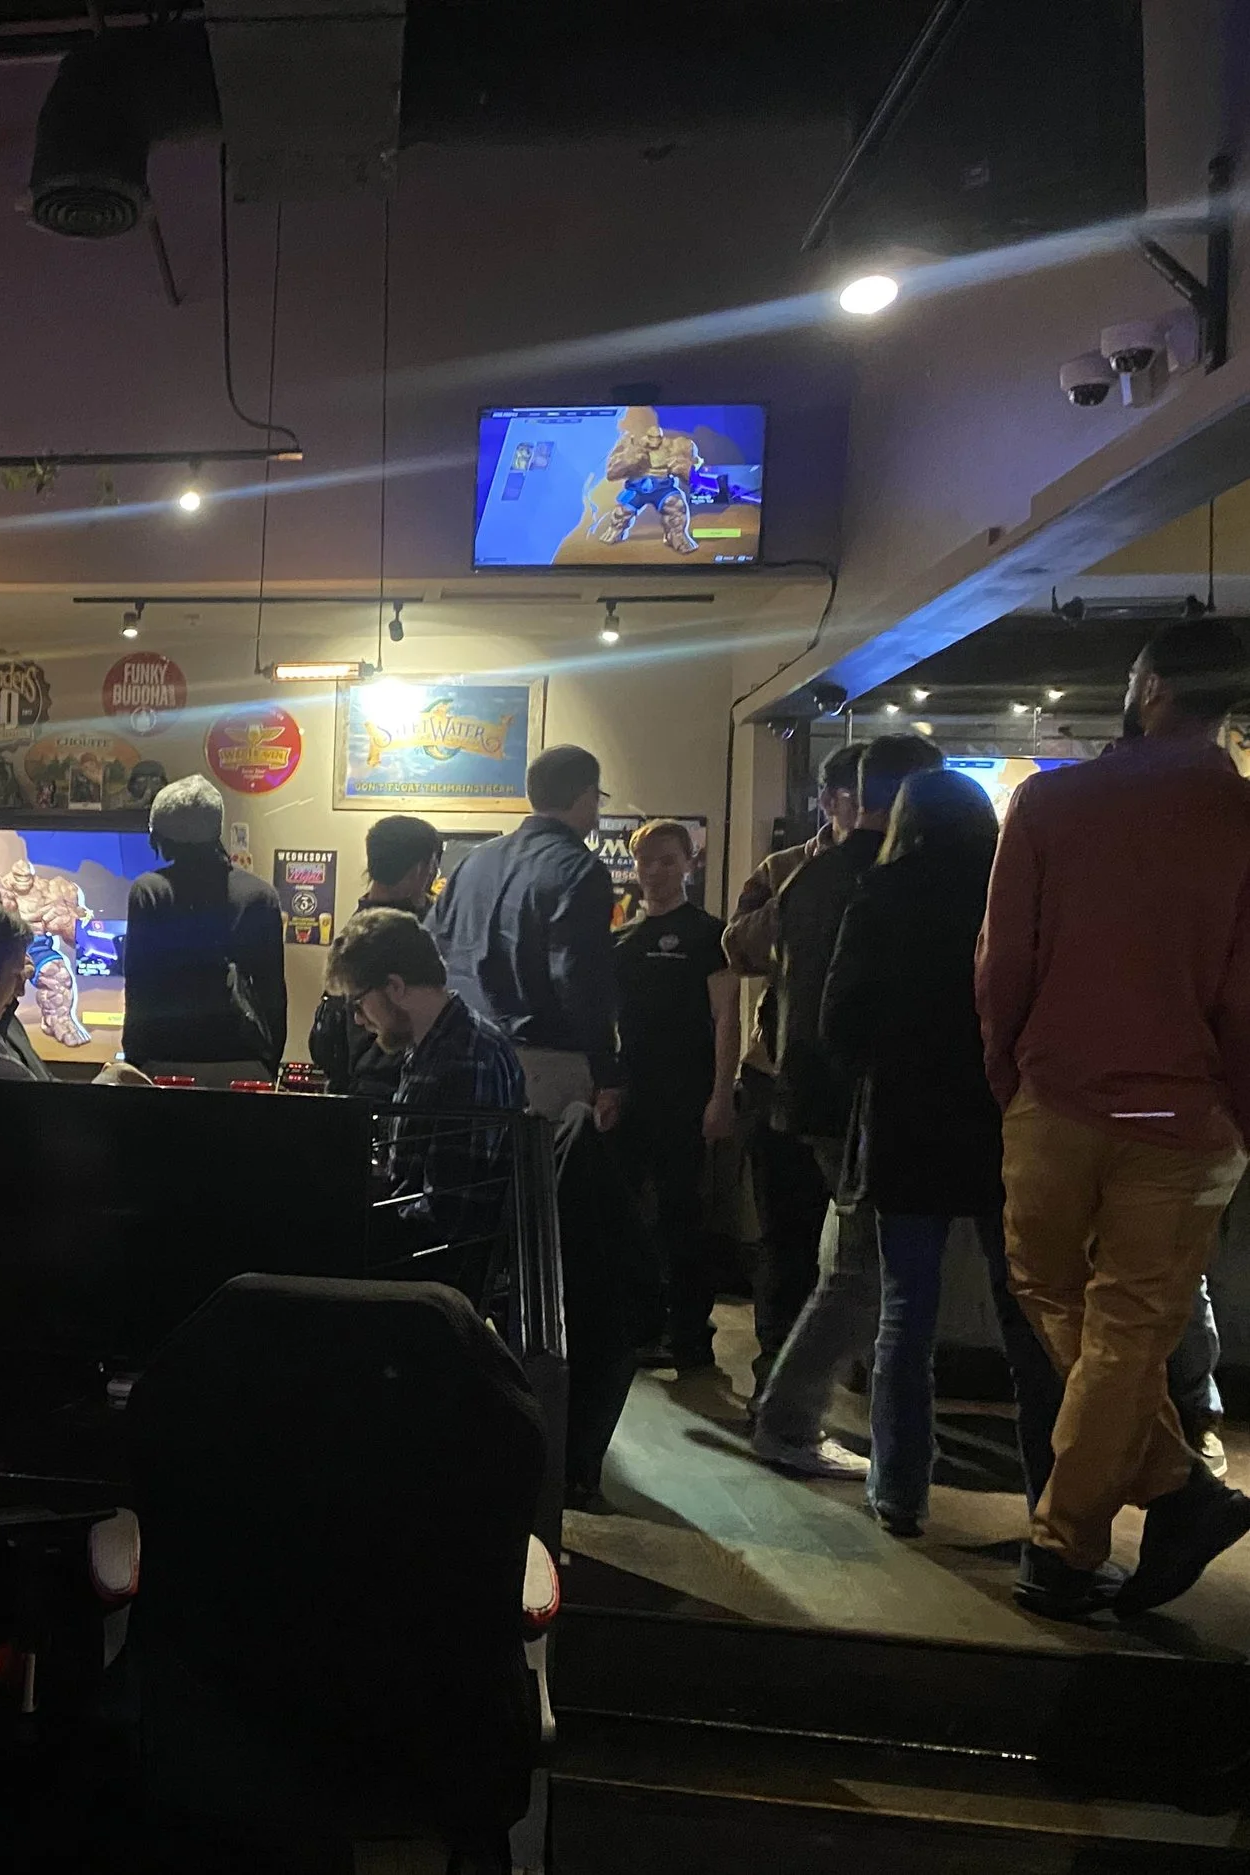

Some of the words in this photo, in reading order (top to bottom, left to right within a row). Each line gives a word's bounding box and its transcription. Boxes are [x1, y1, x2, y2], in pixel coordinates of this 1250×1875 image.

[124, 663, 169, 685] FUNKY
[112, 684, 169, 706] BUDDHA
[278, 852, 333, 862] WEDNESDAY
